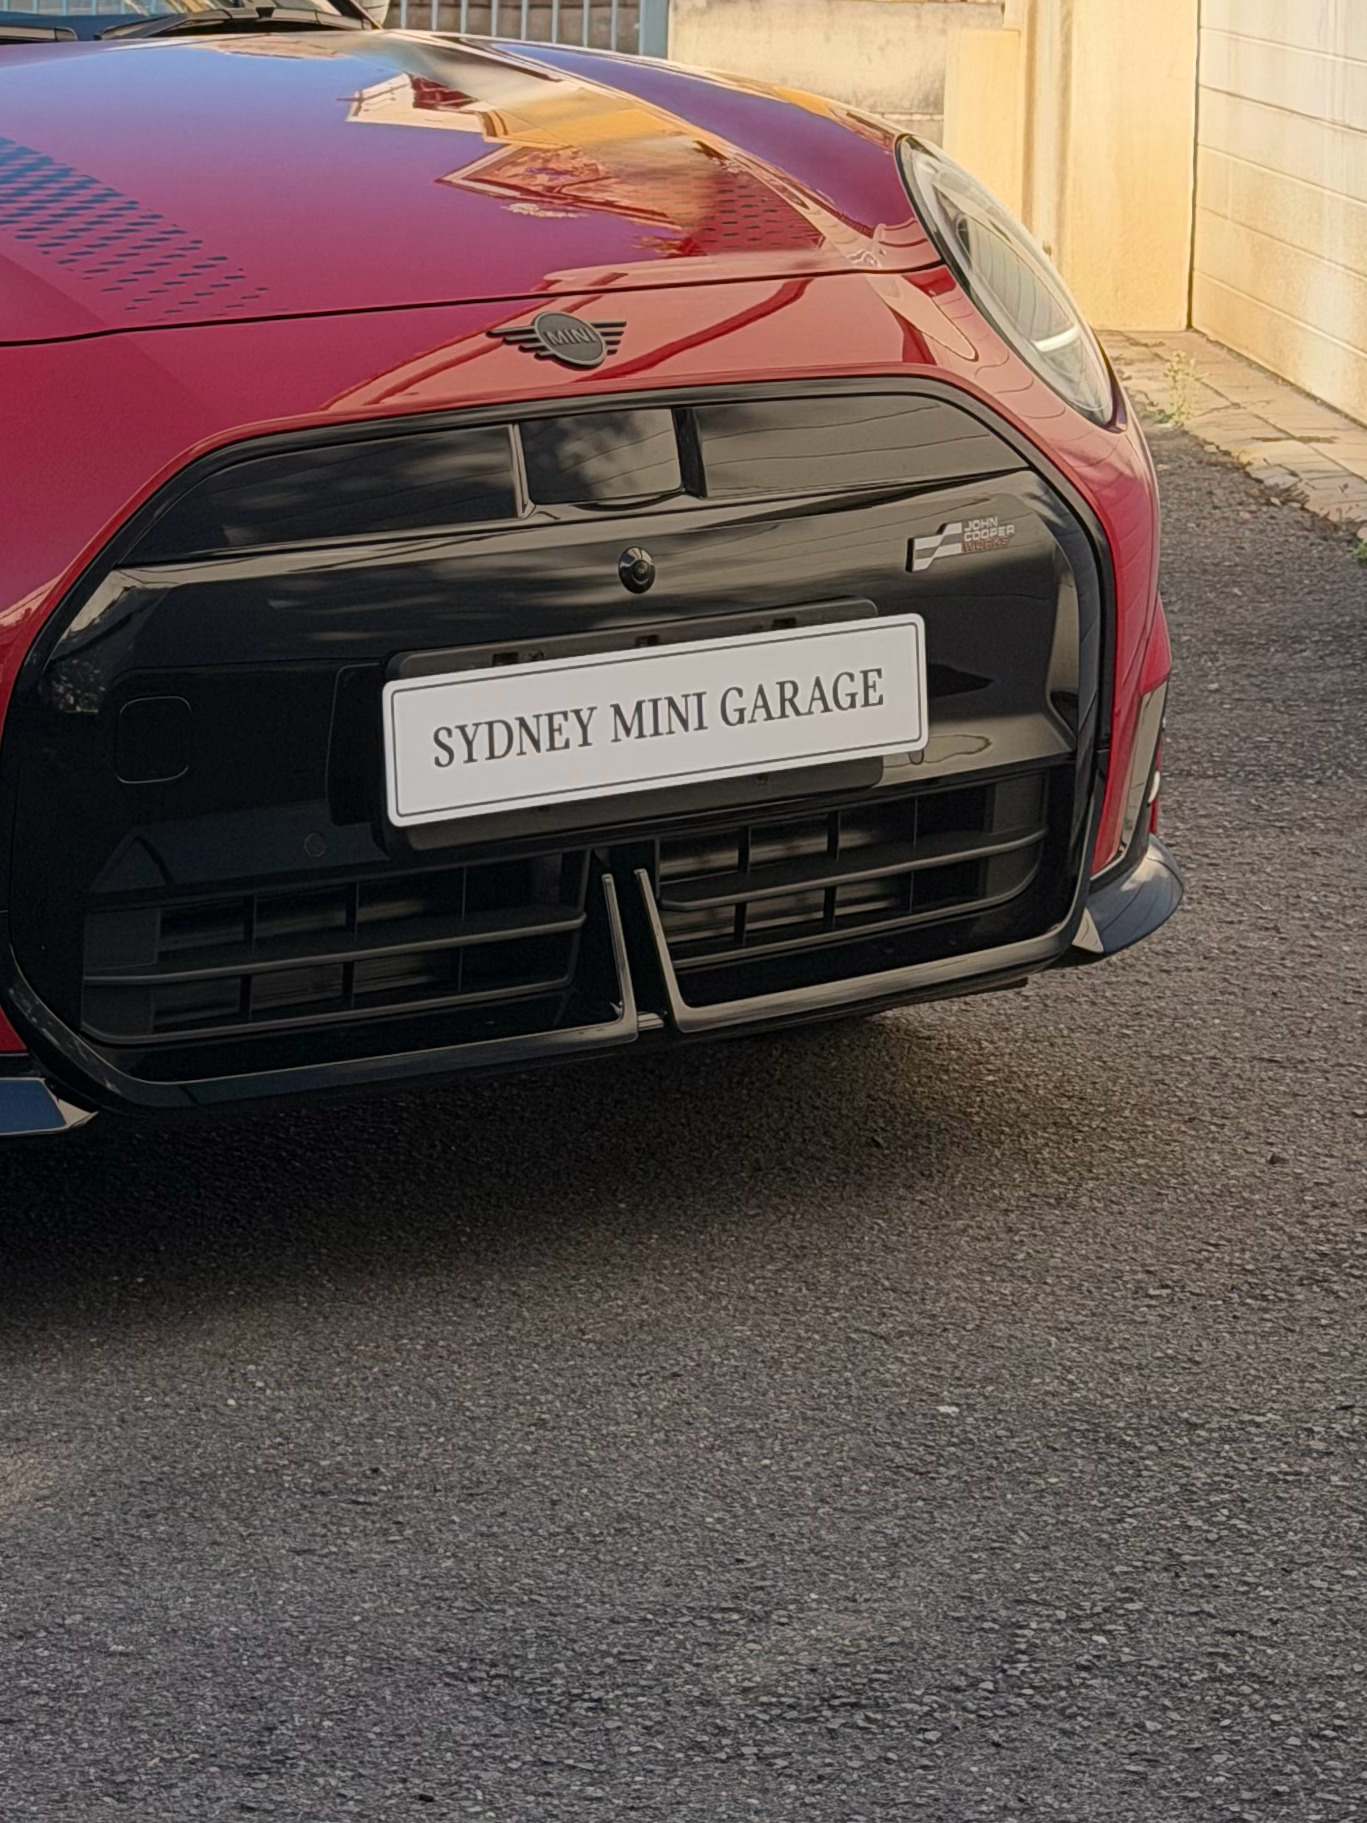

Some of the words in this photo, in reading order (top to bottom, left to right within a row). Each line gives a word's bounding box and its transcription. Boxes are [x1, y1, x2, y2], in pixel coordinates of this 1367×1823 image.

[544, 328, 597, 346] MINI
[964, 516, 998, 532] JOHN
[964, 524, 1015, 542] COOPER
[432, 705, 599, 769] SYDNEY
[609, 691, 710, 744] MINI
[720, 667, 885, 728] GARAGE
